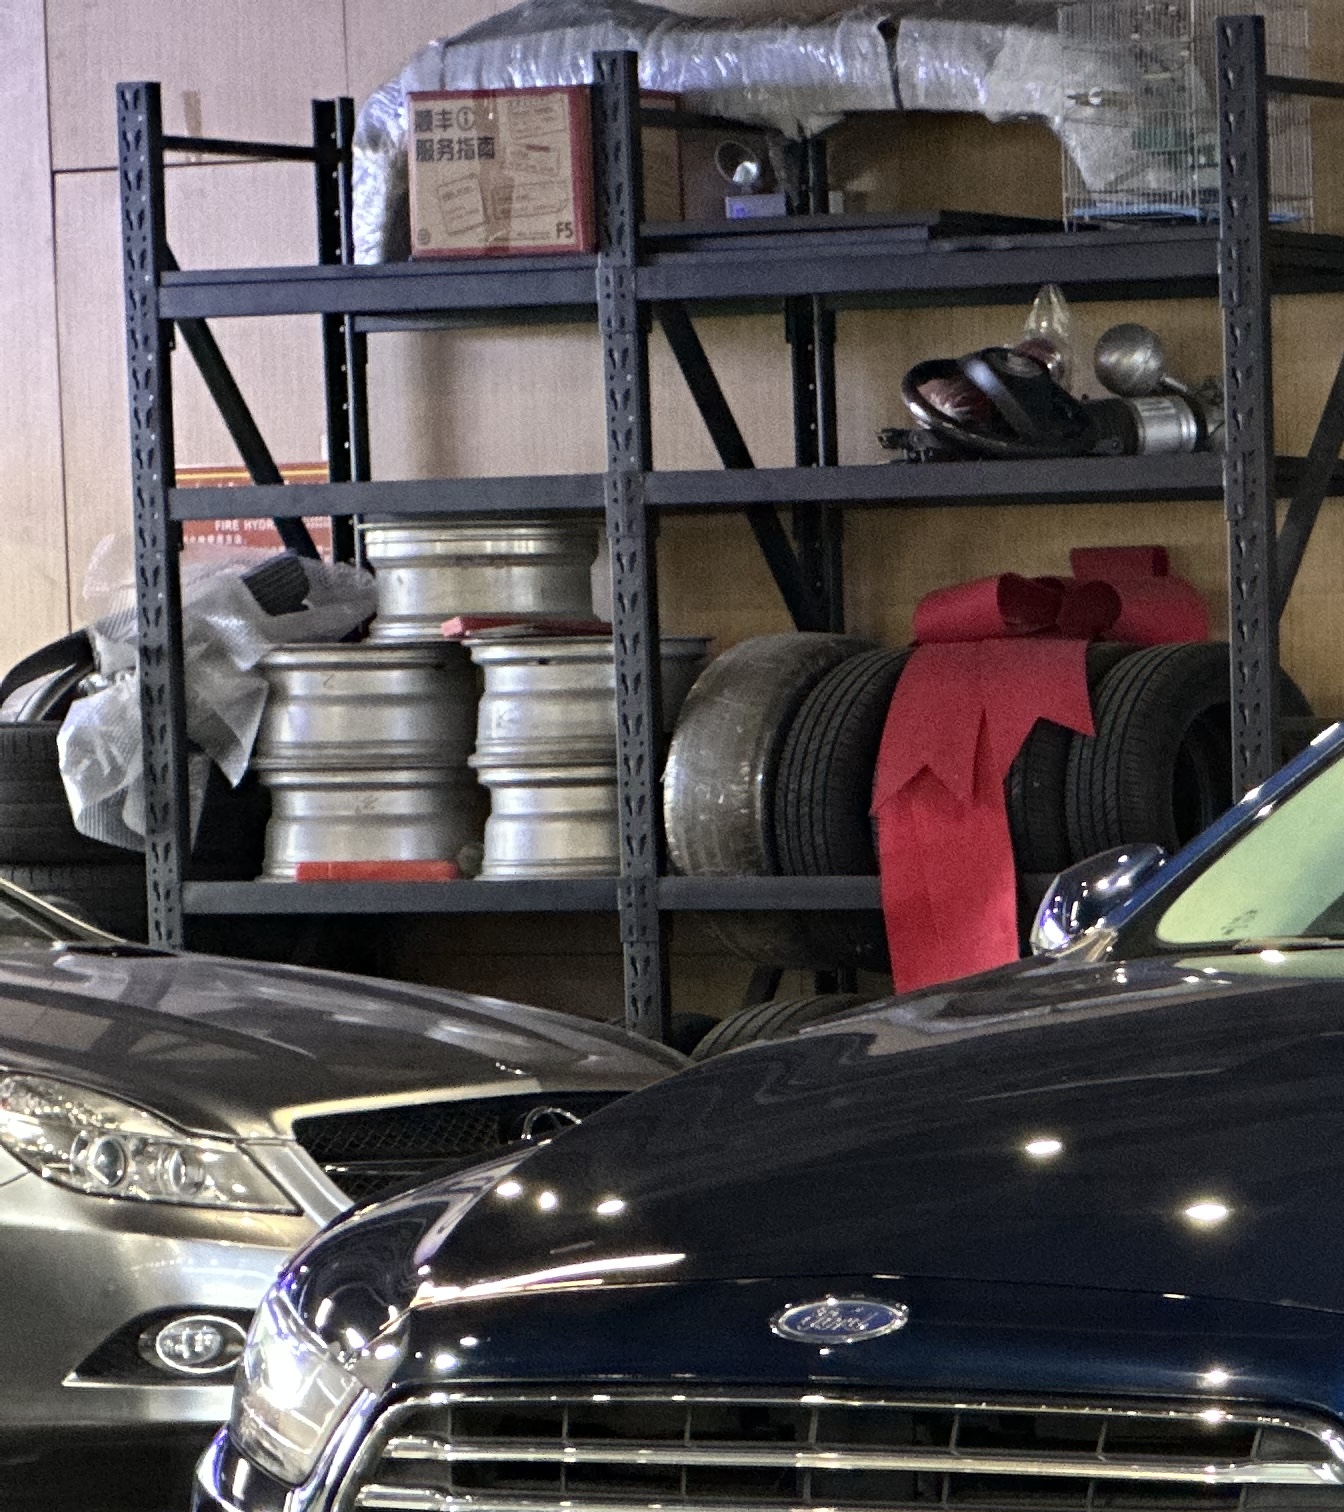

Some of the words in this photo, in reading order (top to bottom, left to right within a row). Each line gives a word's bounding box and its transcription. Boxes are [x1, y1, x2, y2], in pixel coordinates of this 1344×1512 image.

[416, 136, 495, 162] 服务指南
[556, 221, 573, 239] F5
[214, 519, 240, 532] FIRE
[797, 1306, 879, 1332] Ford
